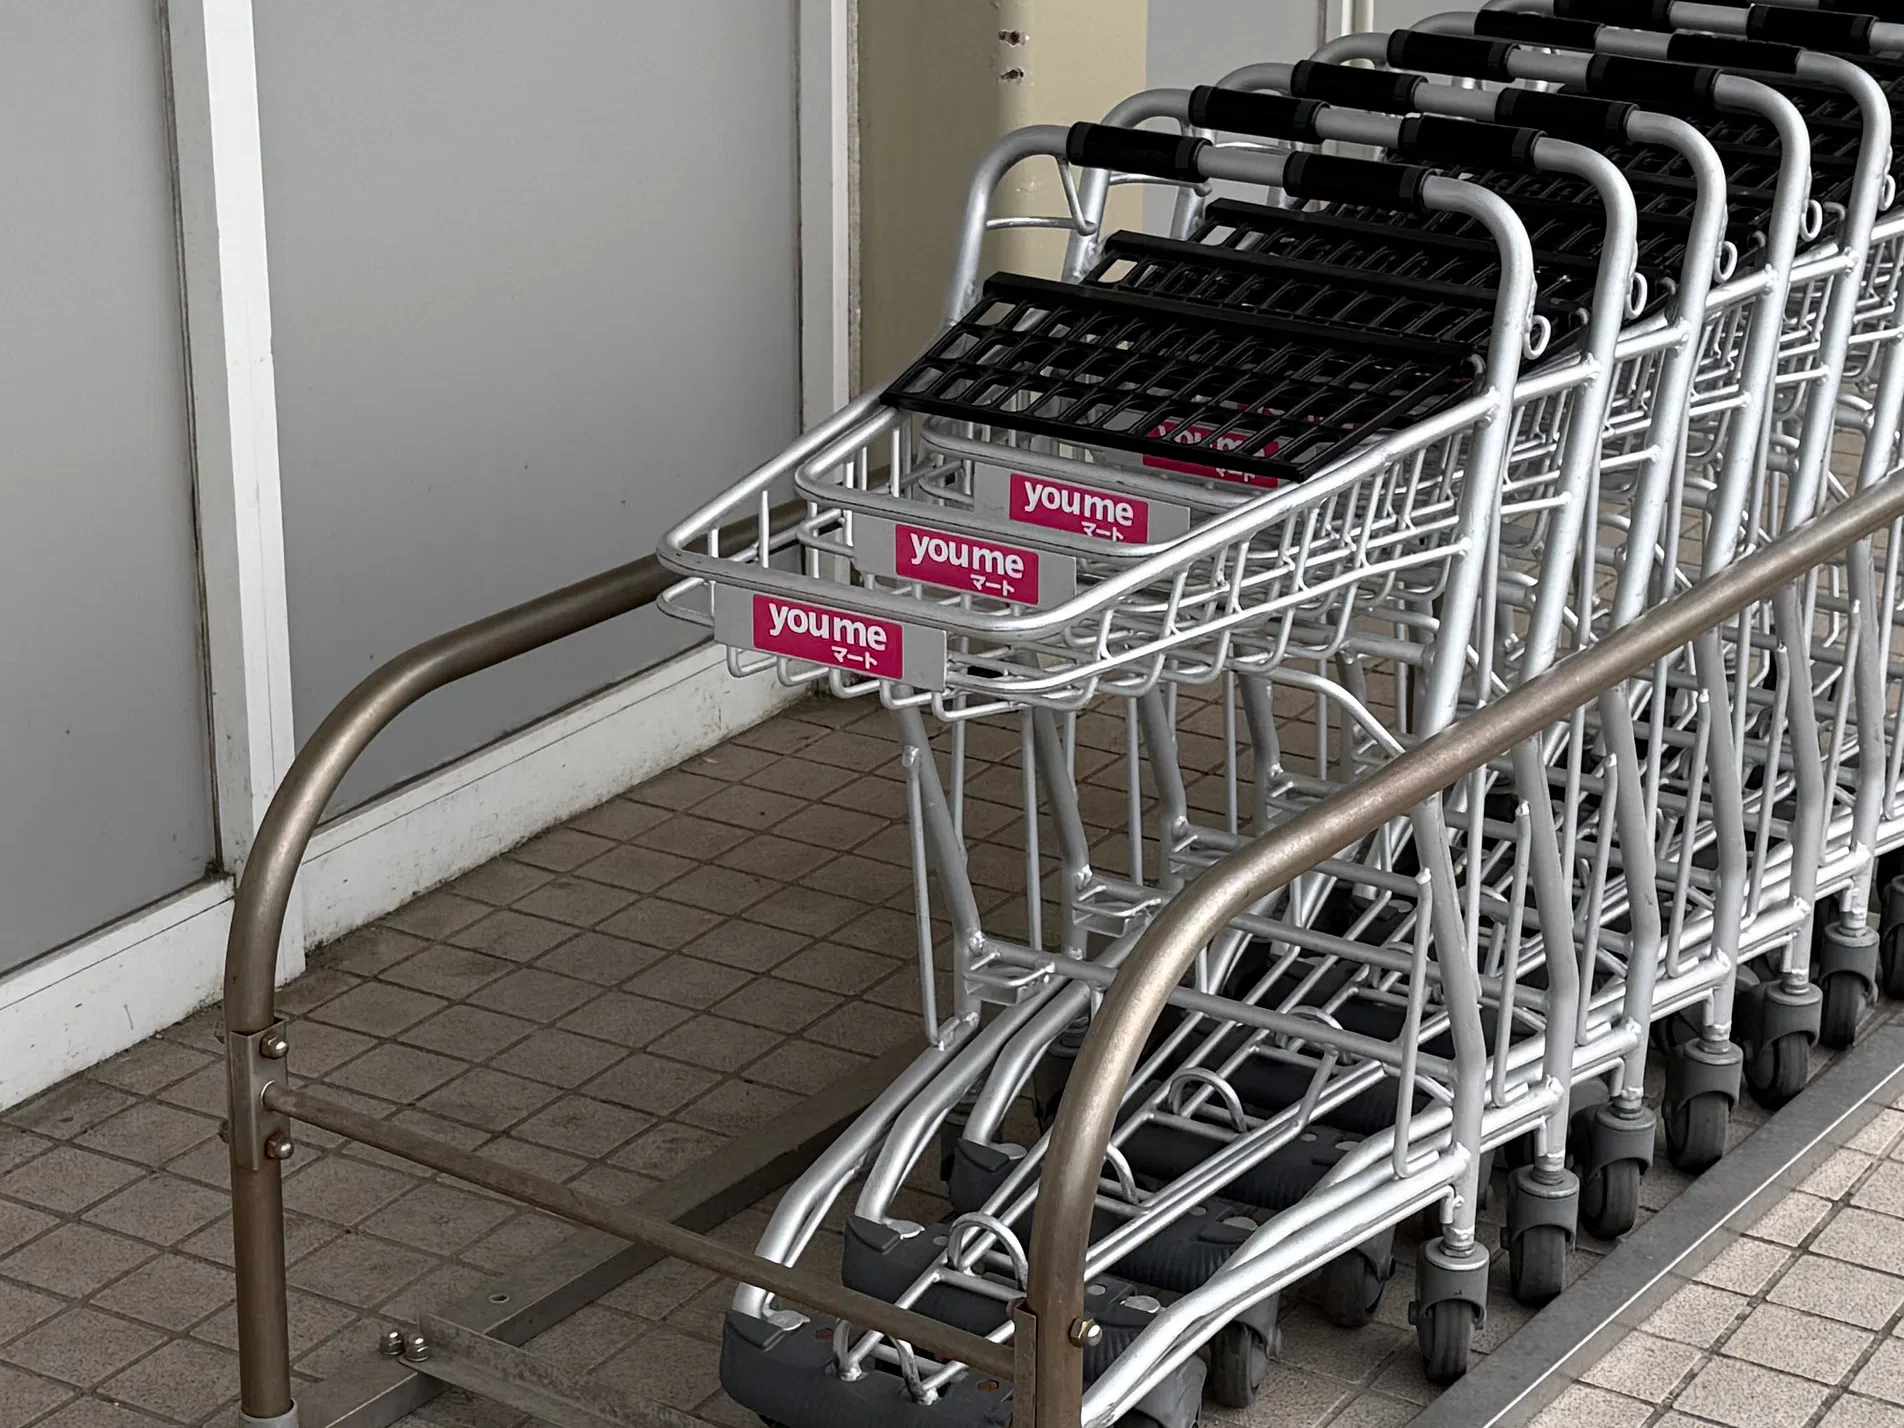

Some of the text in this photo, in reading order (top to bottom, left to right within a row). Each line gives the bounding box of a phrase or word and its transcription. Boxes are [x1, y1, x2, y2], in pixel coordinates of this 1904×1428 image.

[1024, 481, 1135, 528] youme
[909, 532, 1025, 580] youme
[969, 573, 1016, 597] マート
[768, 602, 888, 652] youme
[830, 645, 879, 670] マート
